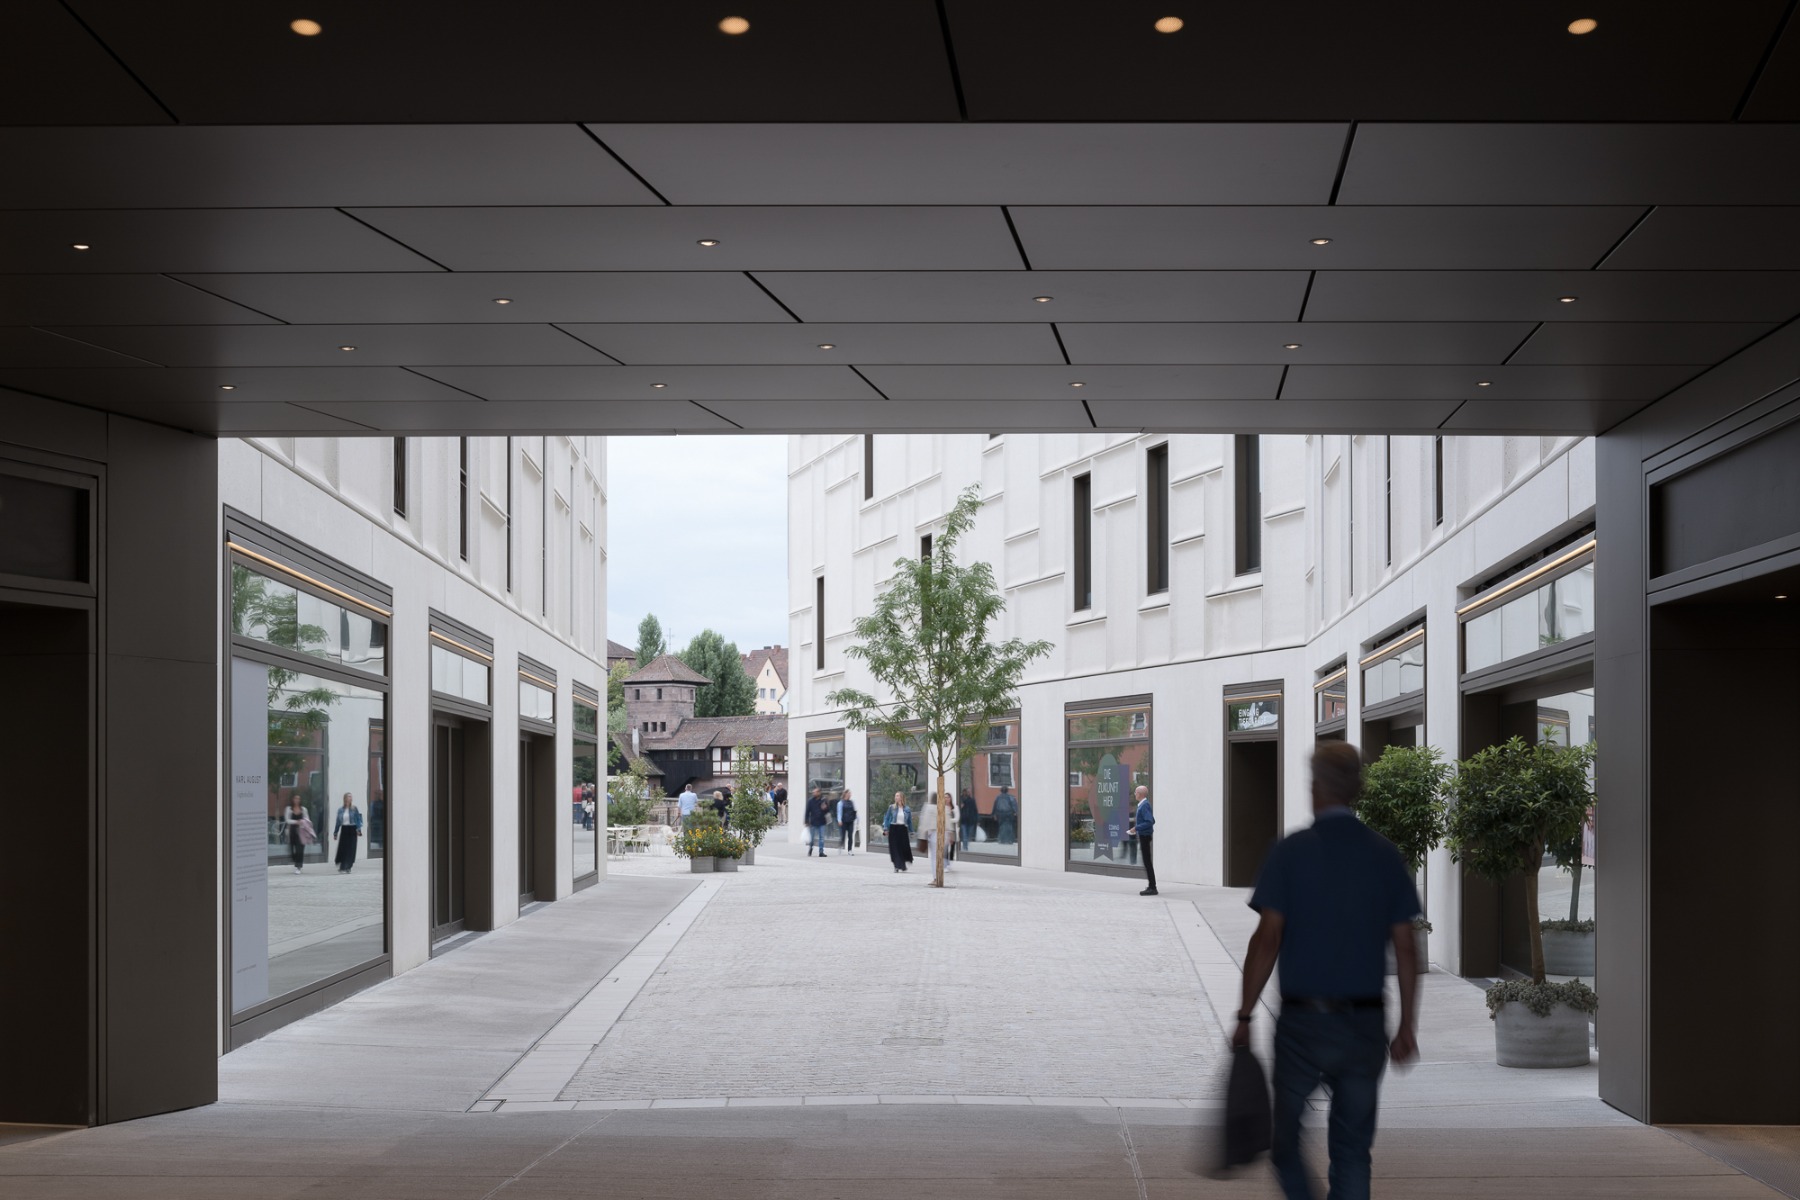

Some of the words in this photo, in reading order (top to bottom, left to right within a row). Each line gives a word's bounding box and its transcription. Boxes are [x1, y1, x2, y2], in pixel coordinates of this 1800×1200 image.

[1239, 708, 1260, 717] EINGNG
[1103, 768, 1111, 779] DIE
[1098, 782, 1119, 793] ZUKUNFT
[1103, 795, 1114, 807] HIER
